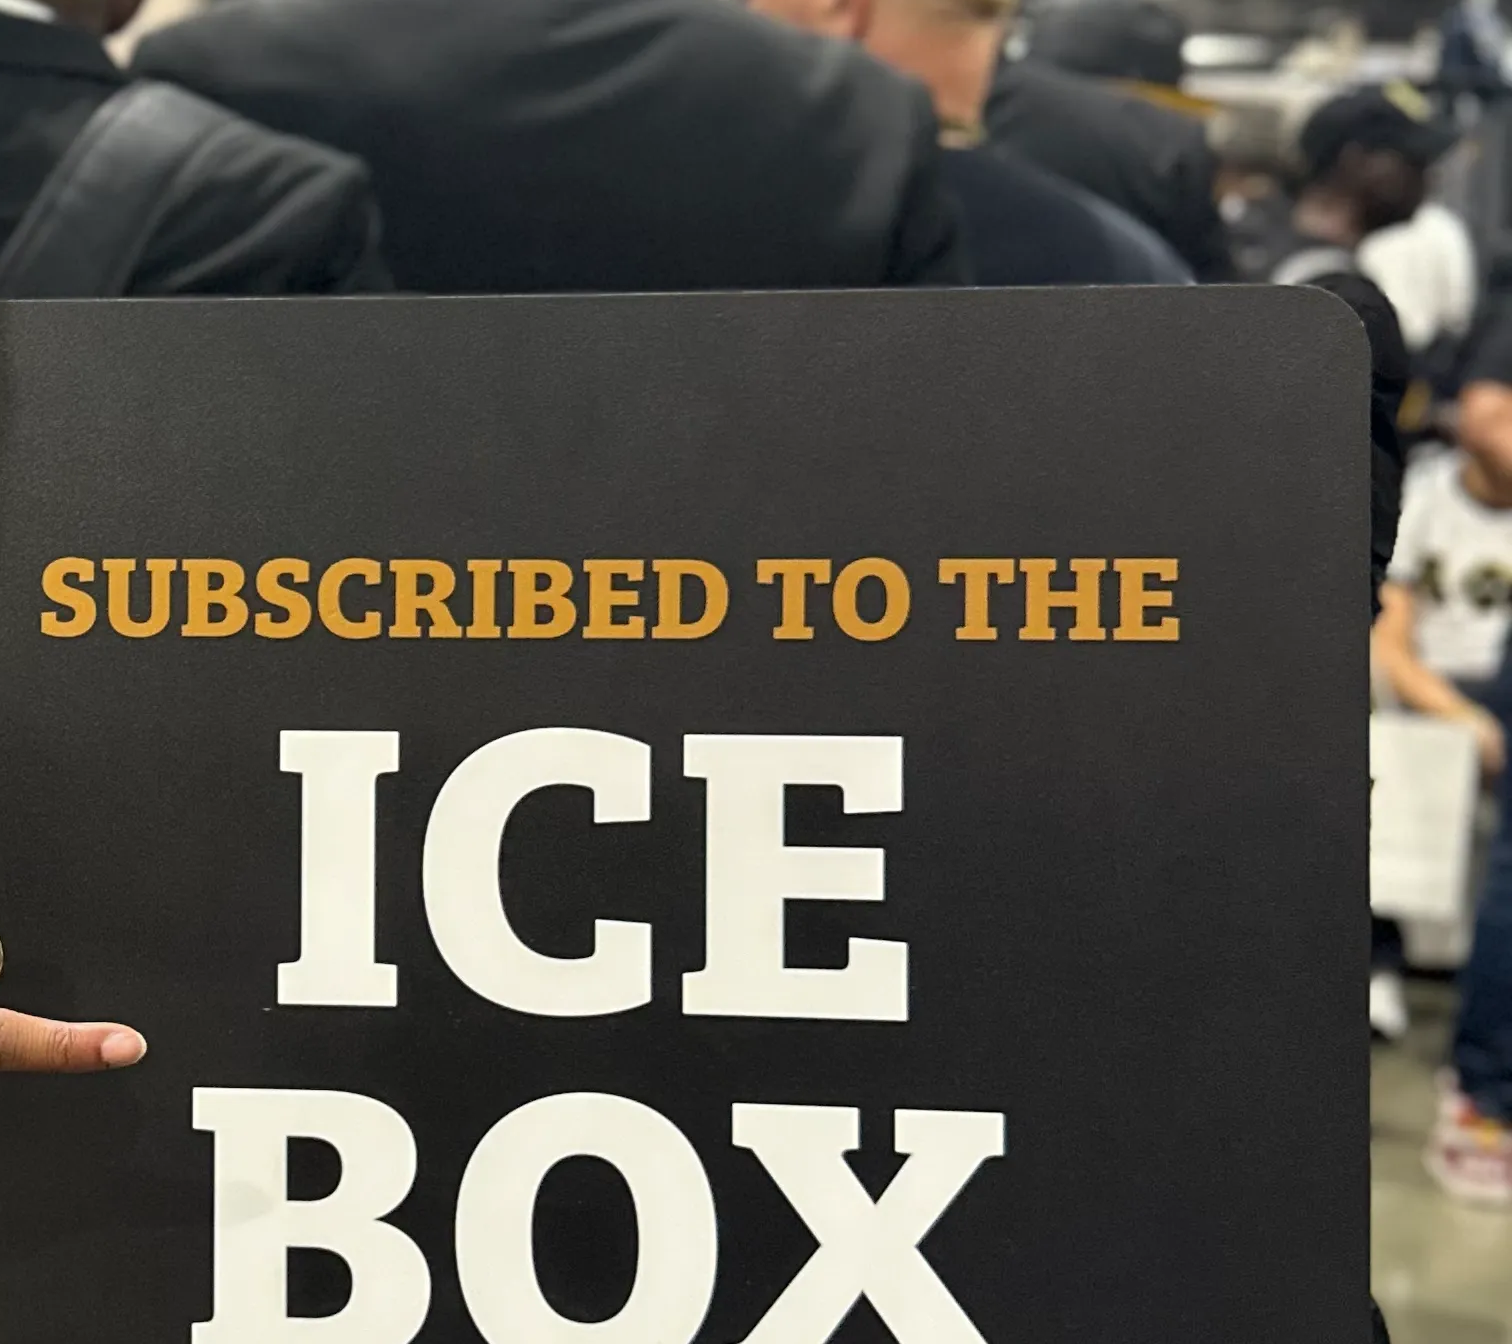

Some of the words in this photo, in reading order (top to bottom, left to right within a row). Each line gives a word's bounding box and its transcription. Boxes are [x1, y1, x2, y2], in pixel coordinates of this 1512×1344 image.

[41, 557, 728, 639] SUBSCRIBED
[757, 558, 910, 641] TO
[939, 558, 1179, 641] THE
[276, 727, 909, 1021] ICE
